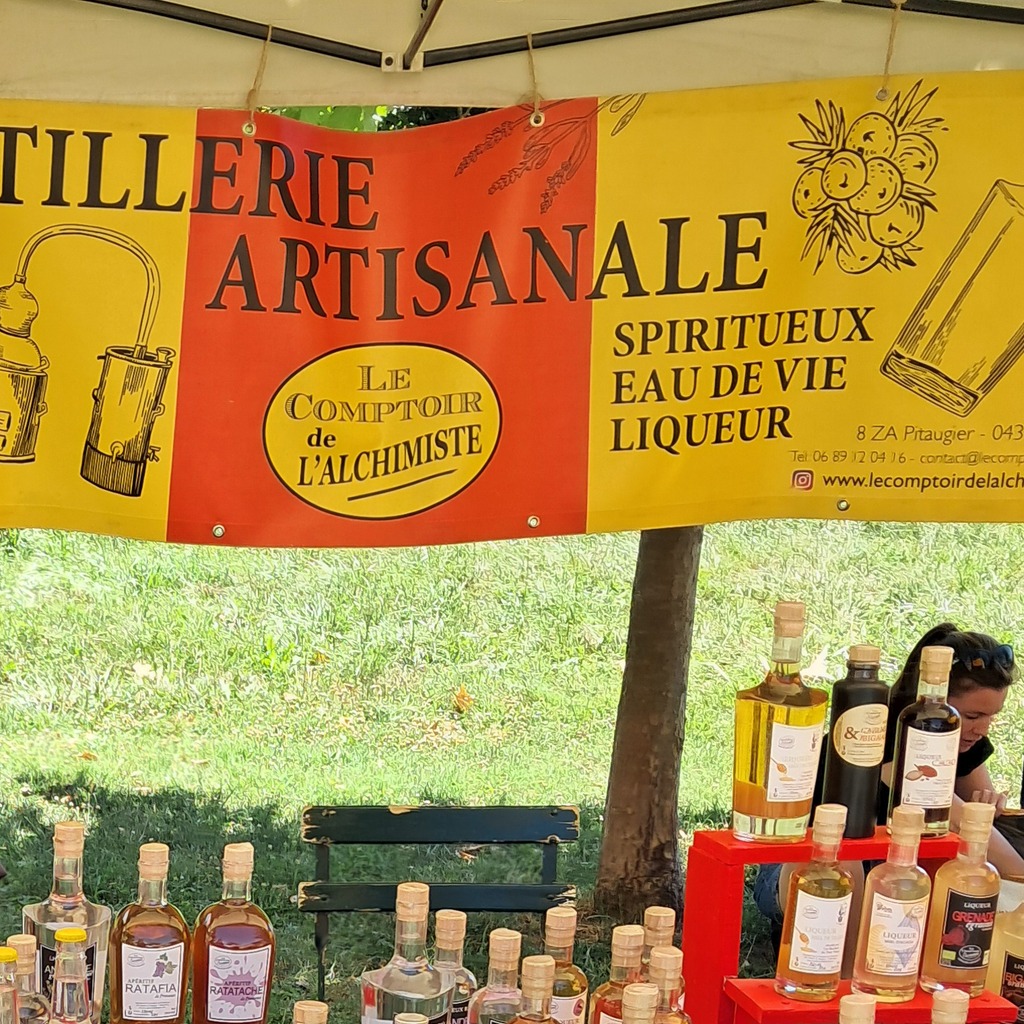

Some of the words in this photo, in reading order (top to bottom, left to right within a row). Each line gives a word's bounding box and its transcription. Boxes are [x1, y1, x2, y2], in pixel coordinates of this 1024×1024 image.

[205, 210, 769, 321] ARTISANALE
[612, 306, 876, 358] SPIRITUEUX
[357, 365, 411, 391] LE
[611, 366, 702, 405] EAU
[711, 361, 763, 399] DE
[774, 356, 849, 392] VIE
[284, 391, 484, 424] COMPTOIR
[307, 427, 337, 449] de
[609, 405, 793, 456] LIQUEUR
[856, 425, 867, 441] 8
[871, 425, 898, 441] ZA
[903, 425, 976, 446] Pitaugier
[296, 424, 483, 486] L'ALCHIMISTE
[813, 450, 829, 462] 06
[832, 450, 848, 463] 89
[852, 450, 866, 463] 12
[870, 450, 886, 464] 04
[891, 451, 907, 464] 16
[952, 910, 996, 923] GRENADE
[125, 983, 177, 994] RATAFIA
[210, 985, 263, 996] RATATACHE
